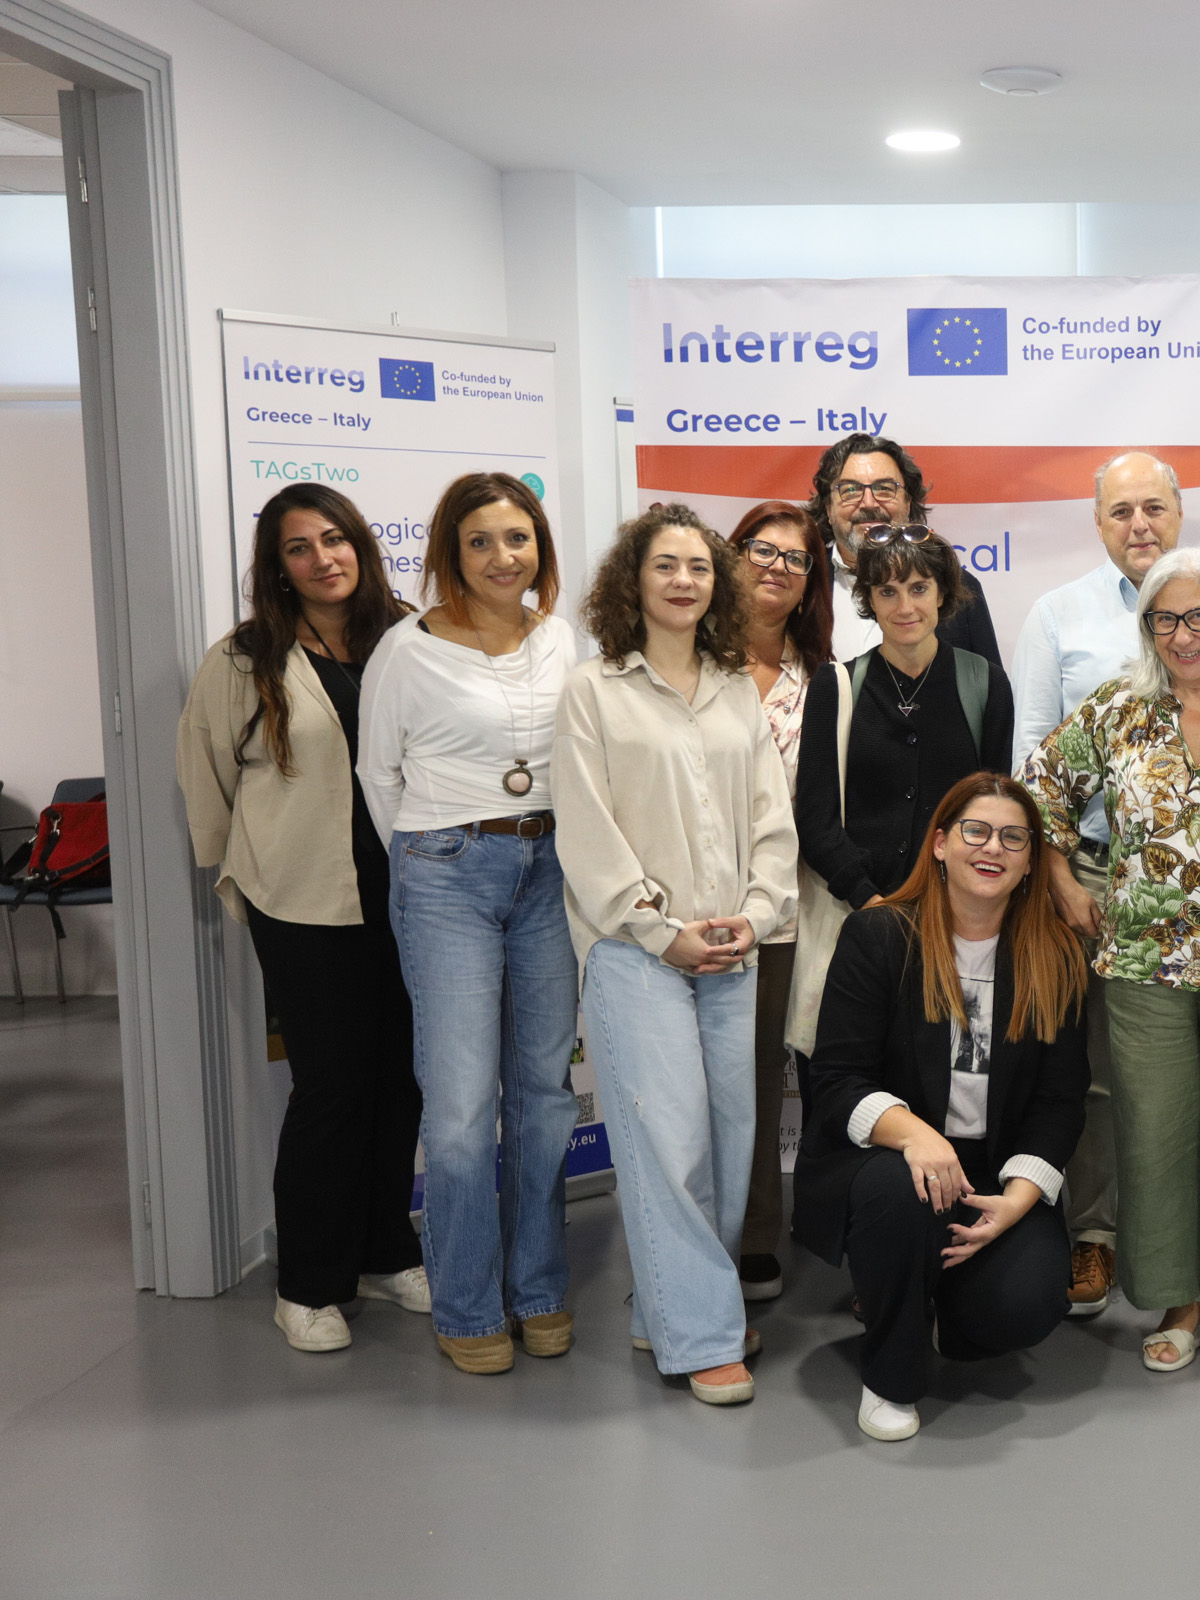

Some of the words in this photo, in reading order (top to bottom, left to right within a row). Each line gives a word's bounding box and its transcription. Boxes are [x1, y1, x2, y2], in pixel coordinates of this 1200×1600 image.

[1022, 316, 1130, 334] Co-funded
[1137, 316, 1162, 337] by
[662, 322, 879, 370] Interreg
[1022, 344, 1054, 361] the
[1061, 343, 1160, 363] European
[243, 356, 366, 393] Interreg
[441, 370, 496, 385] Co-funded
[499, 375, 512, 388] by
[442, 385, 460, 396] the
[462, 386, 512, 400] European
[514, 391, 544, 402] Union
[246, 406, 313, 425] Greece
[333, 412, 372, 431] Italy
[666, 409, 781, 433] Greece
[817, 406, 888, 437] Italy
[250, 460, 360, 482] TAGsTwo
